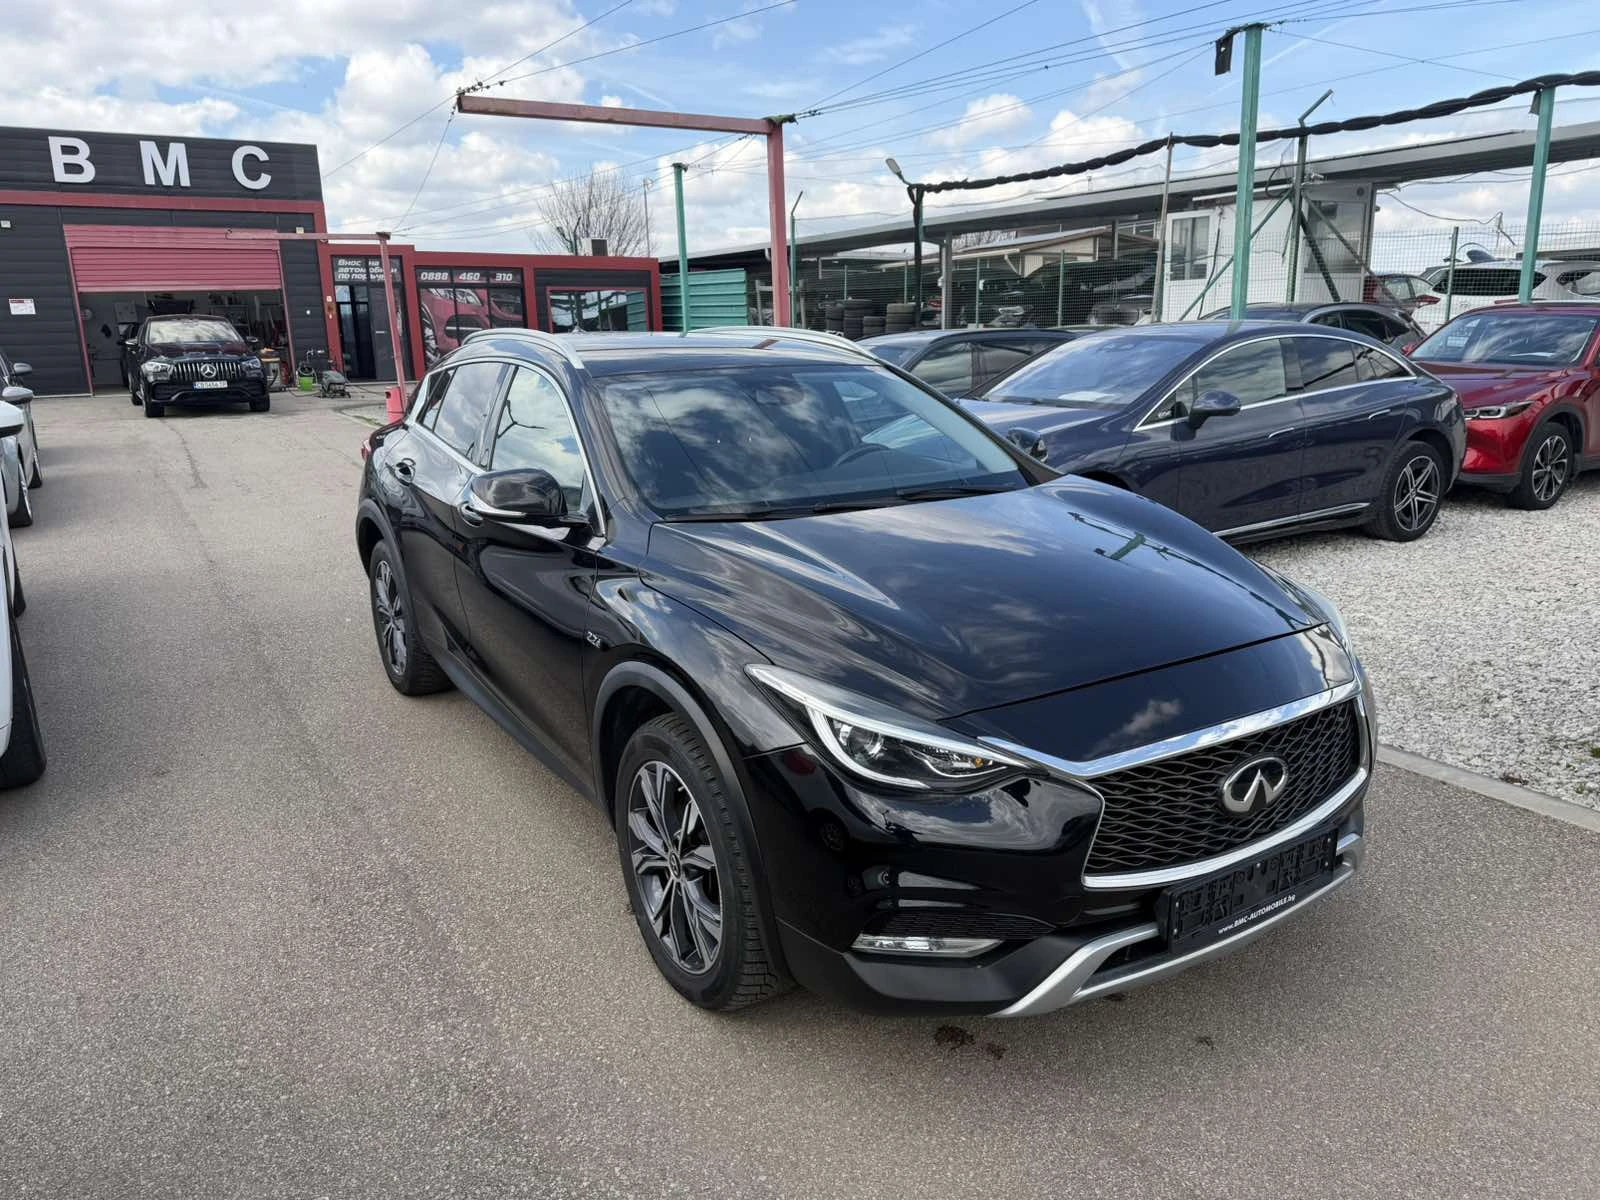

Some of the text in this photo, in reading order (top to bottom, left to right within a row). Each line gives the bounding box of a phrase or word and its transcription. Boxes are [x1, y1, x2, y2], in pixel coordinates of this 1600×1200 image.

[420, 272, 513, 281] 0888 460 310
[1217, 894, 1296, 934] www.BMC-AUTOMOBILE.bg
